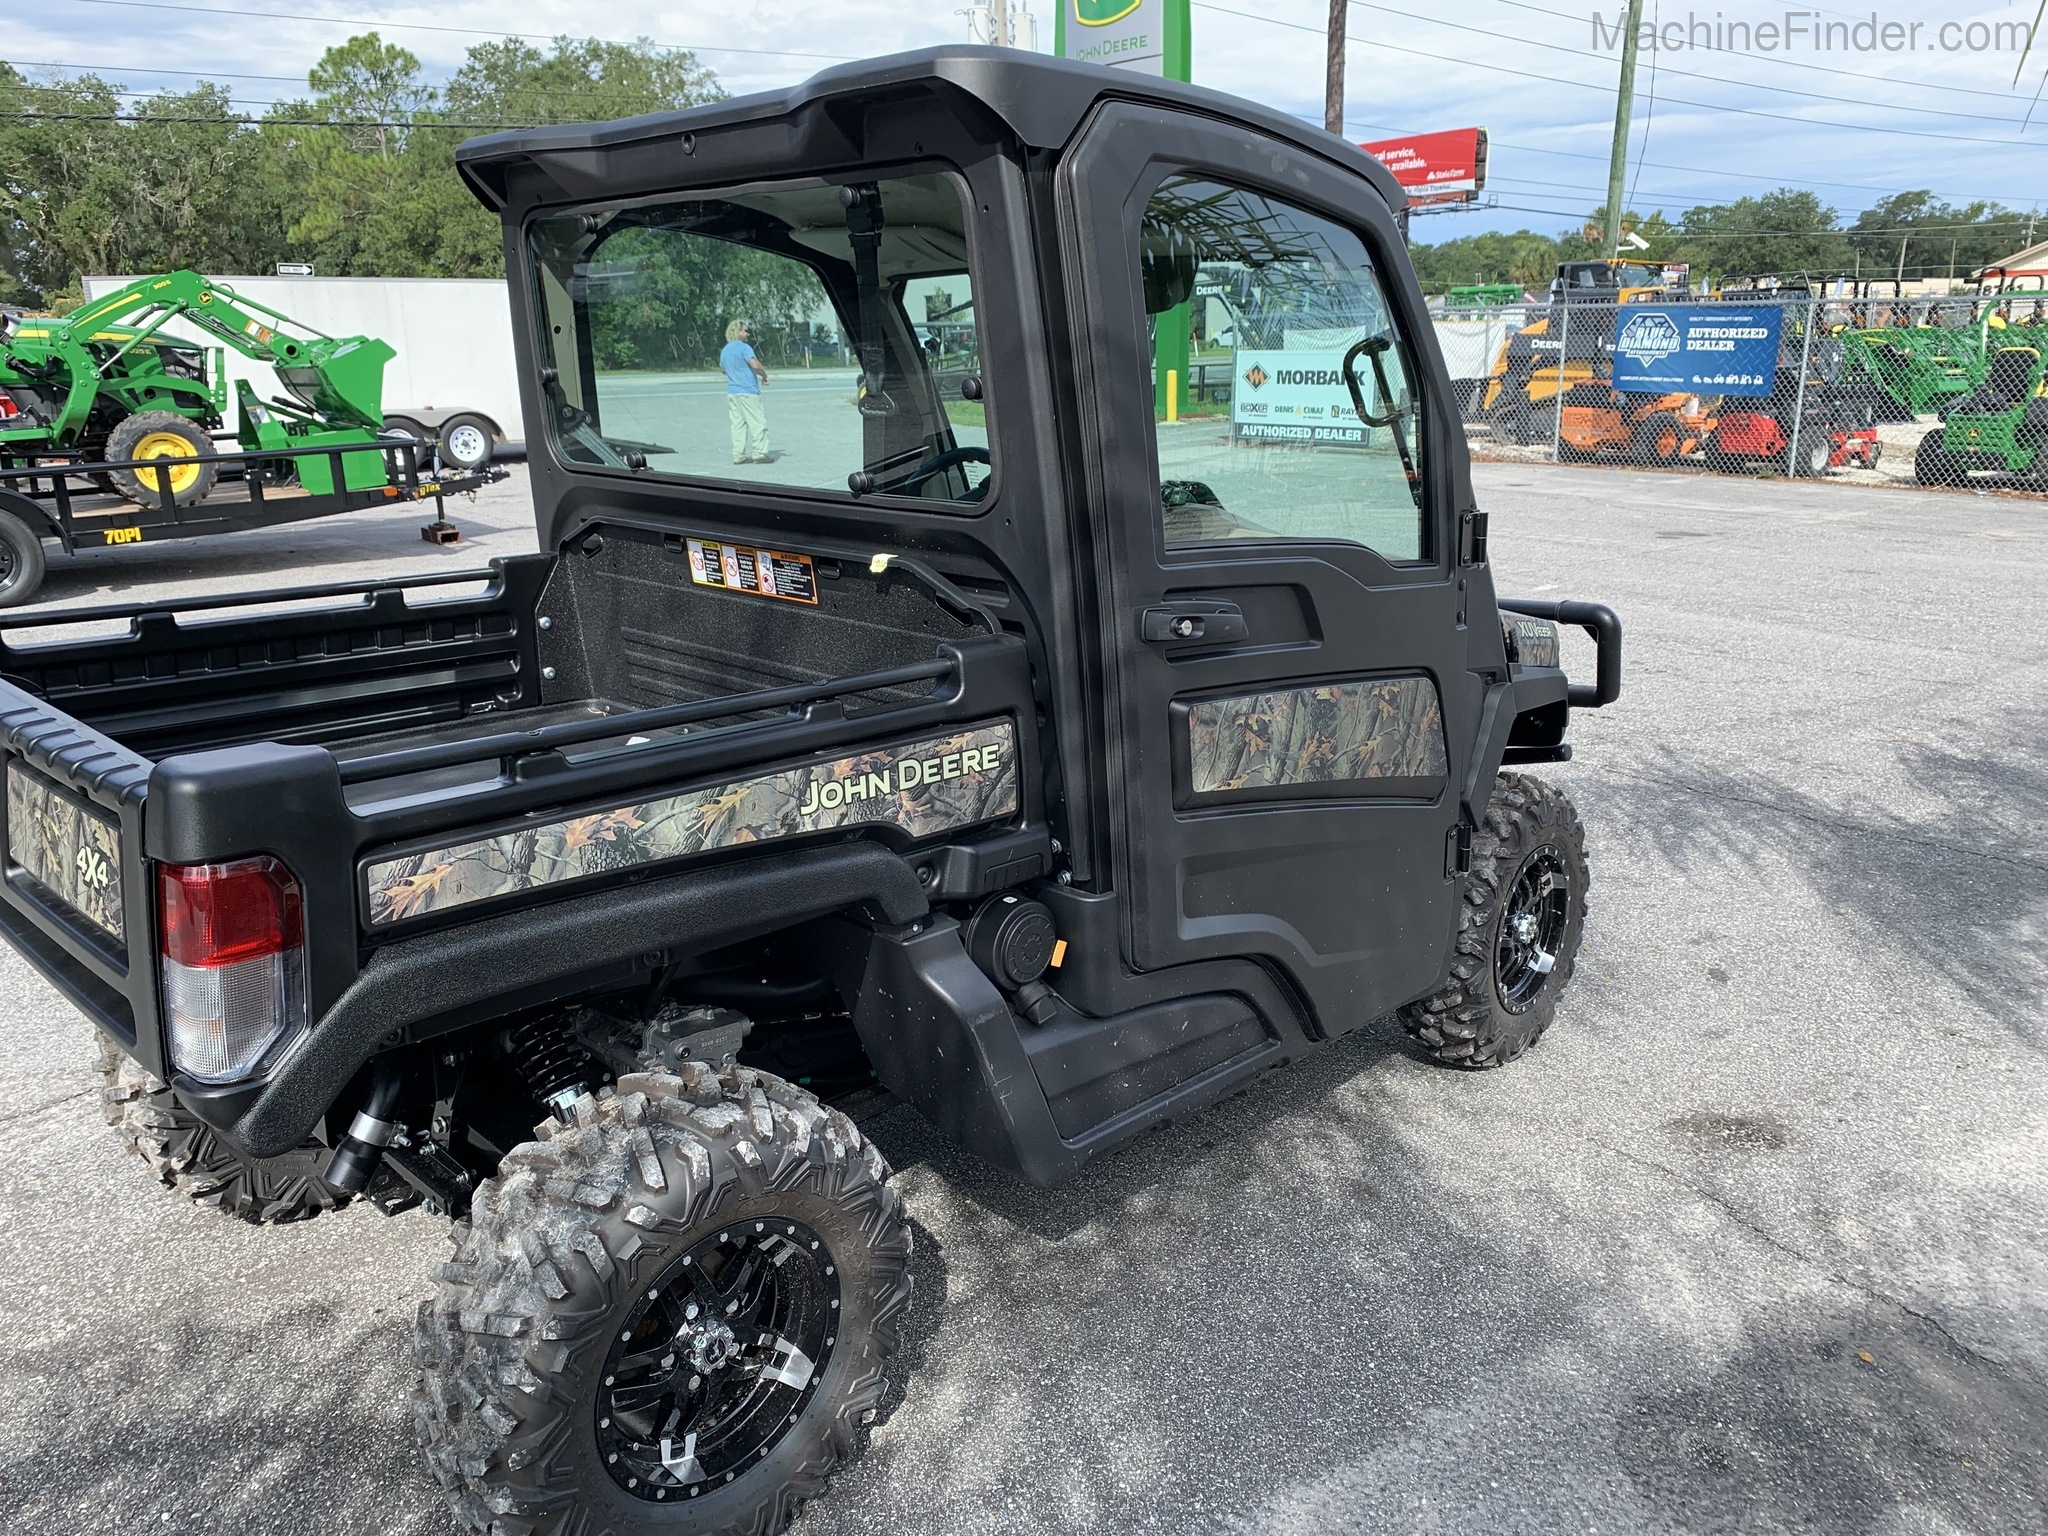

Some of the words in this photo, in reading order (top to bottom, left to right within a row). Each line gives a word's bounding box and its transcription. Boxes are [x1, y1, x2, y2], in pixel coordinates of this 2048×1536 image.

[1103, 35, 1148, 56] DEERE
[1386, 147, 1416, 160] service,
[1391, 157, 1427, 171] available.
[1636, 326, 1667, 338] BLUE
[1687, 327, 1769, 339] AUTHORIZED
[1620, 336, 1679, 350] DIAMOND
[1686, 340, 1736, 351] DEALER
[1240, 403, 1268, 414] BOXER
[1274, 405, 1294, 414] DENIS
[1241, 425, 1312, 439] AUTHORIZED
[1314, 428, 1362, 442] DEALER
[419, 483, 441, 496] gTex
[800, 768, 892, 817] JOHN
[897, 742, 1001, 792] DEERE
